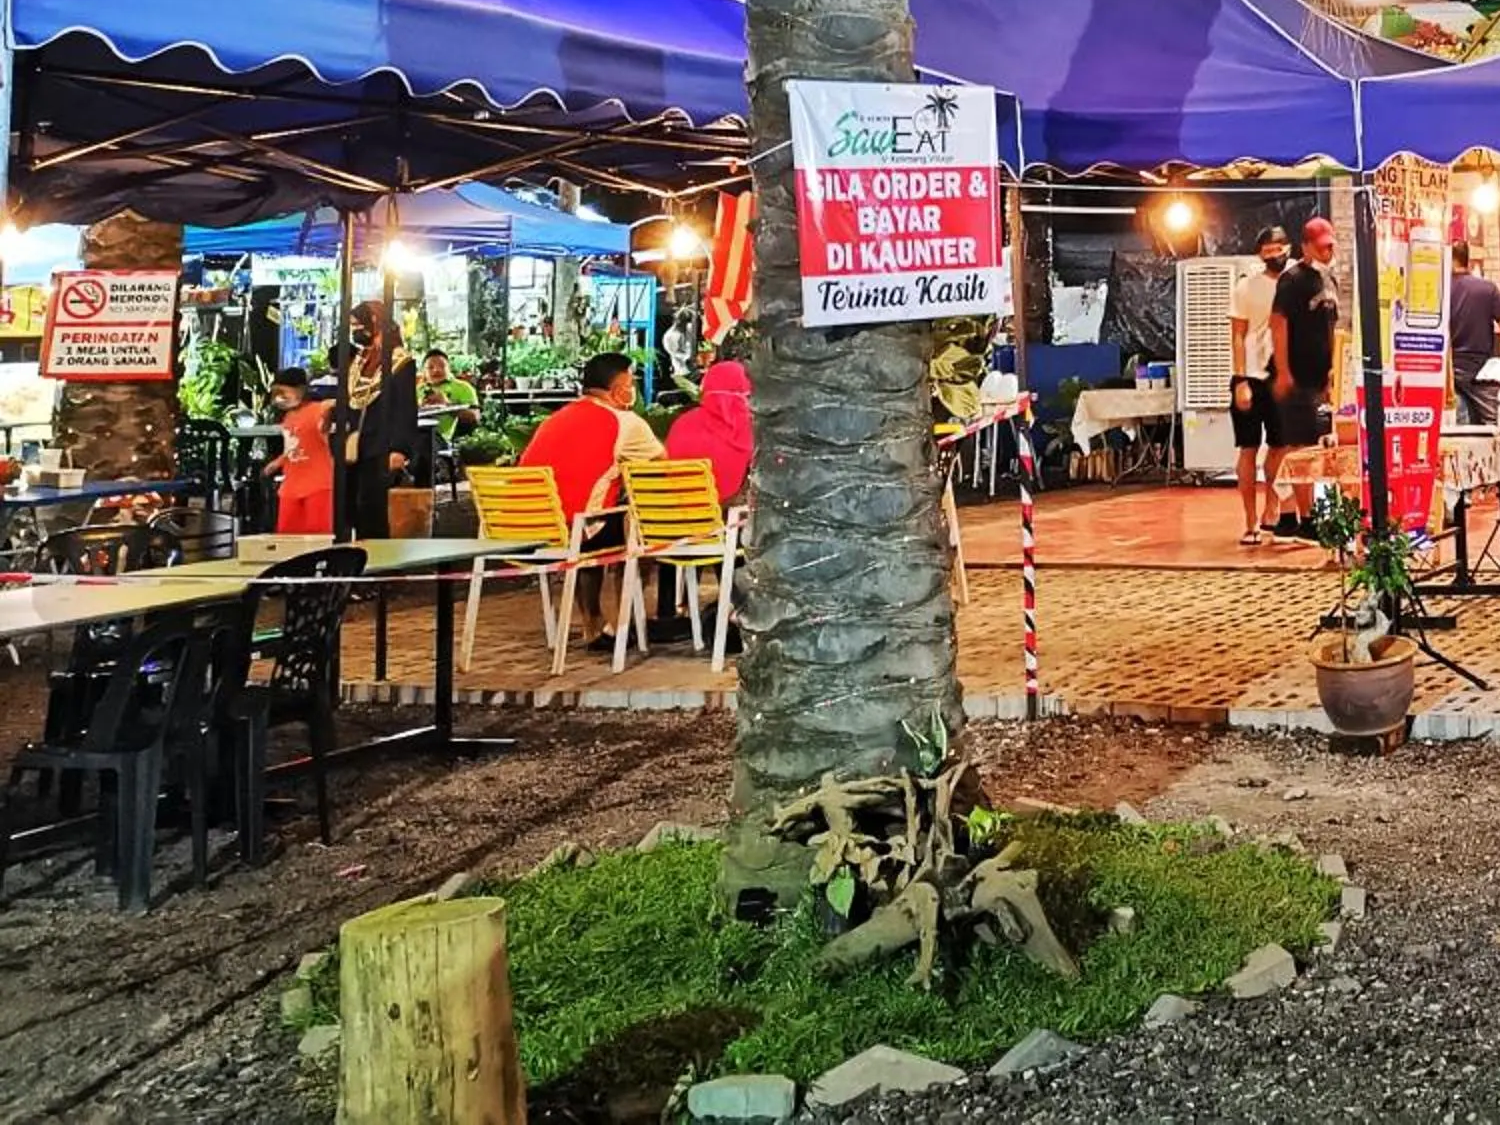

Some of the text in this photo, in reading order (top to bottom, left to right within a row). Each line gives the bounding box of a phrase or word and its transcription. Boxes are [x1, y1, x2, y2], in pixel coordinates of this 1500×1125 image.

[806, 171, 988, 201] SILA ORDER &
[858, 205, 941, 235] BAYAR
[827, 237, 977, 272] DI KAUNTER
[110, 283, 171, 293] DILARANG
[818, 273, 988, 311] Terima Kasih
[109, 294, 169, 304] MEROKOK
[60, 332, 159, 344] PERINGATAN
[76, 345, 107, 355] MEJA
[111, 345, 151, 355] UNTUK
[55, 356, 157, 366] 2 ORANG SAHAJA
